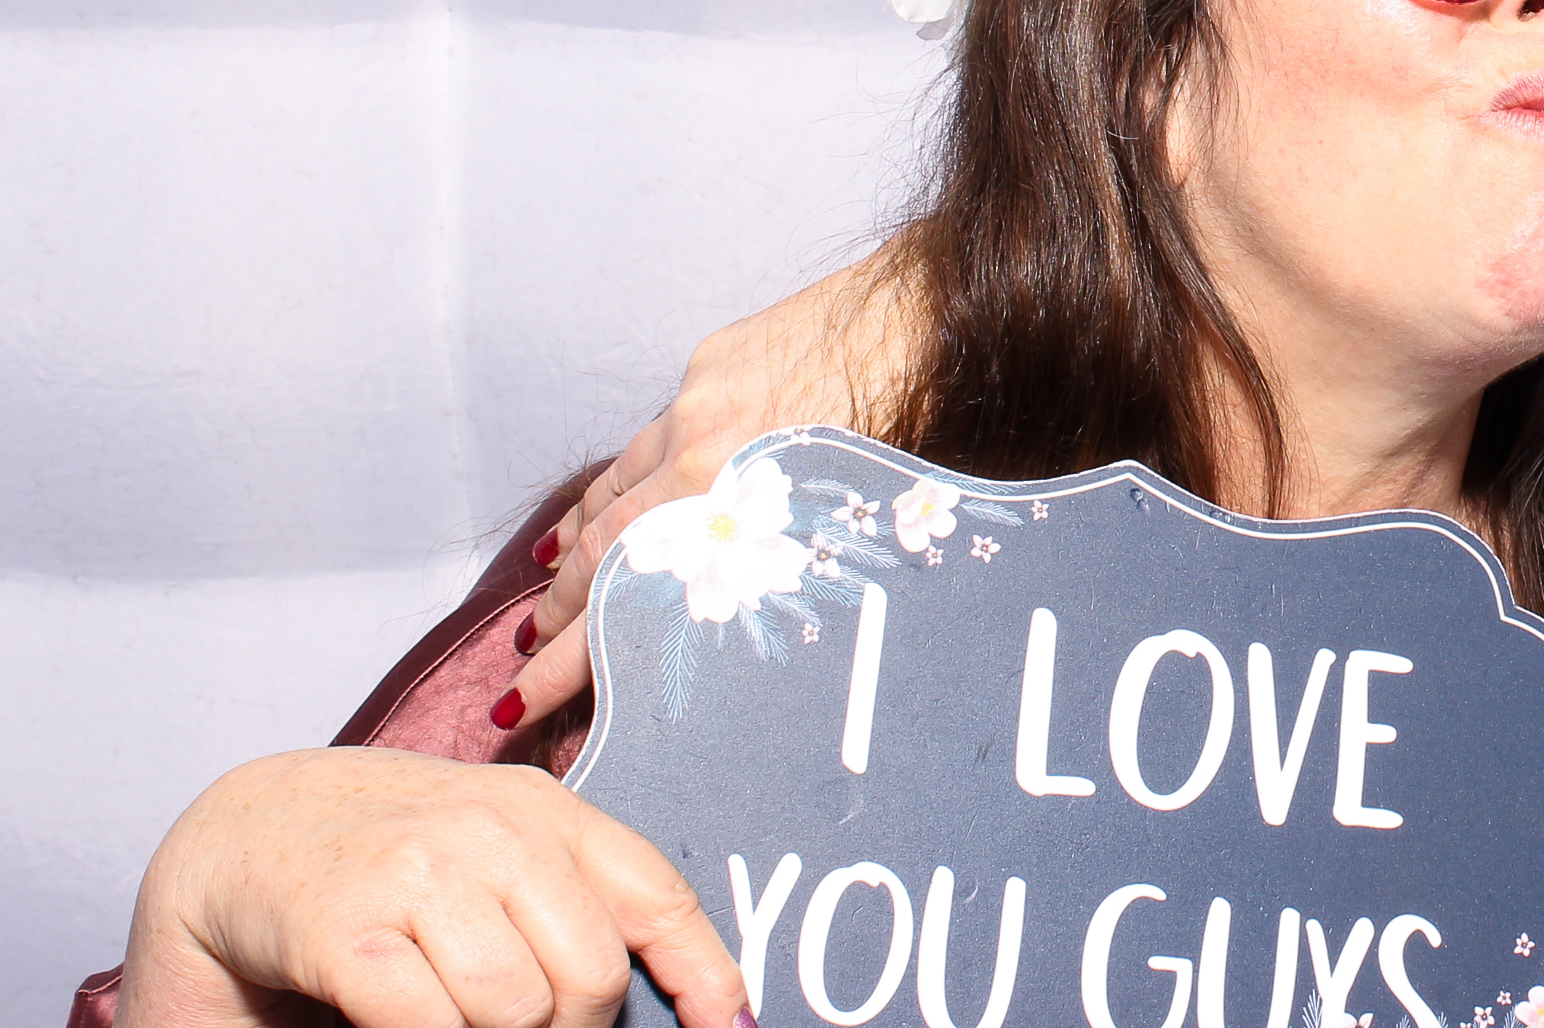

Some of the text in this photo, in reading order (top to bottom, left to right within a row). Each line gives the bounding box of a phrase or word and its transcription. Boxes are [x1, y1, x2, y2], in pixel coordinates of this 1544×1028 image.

[841, 583, 1414, 829] I LOVE
[726, 852, 1442, 1028] YOU GUYS
